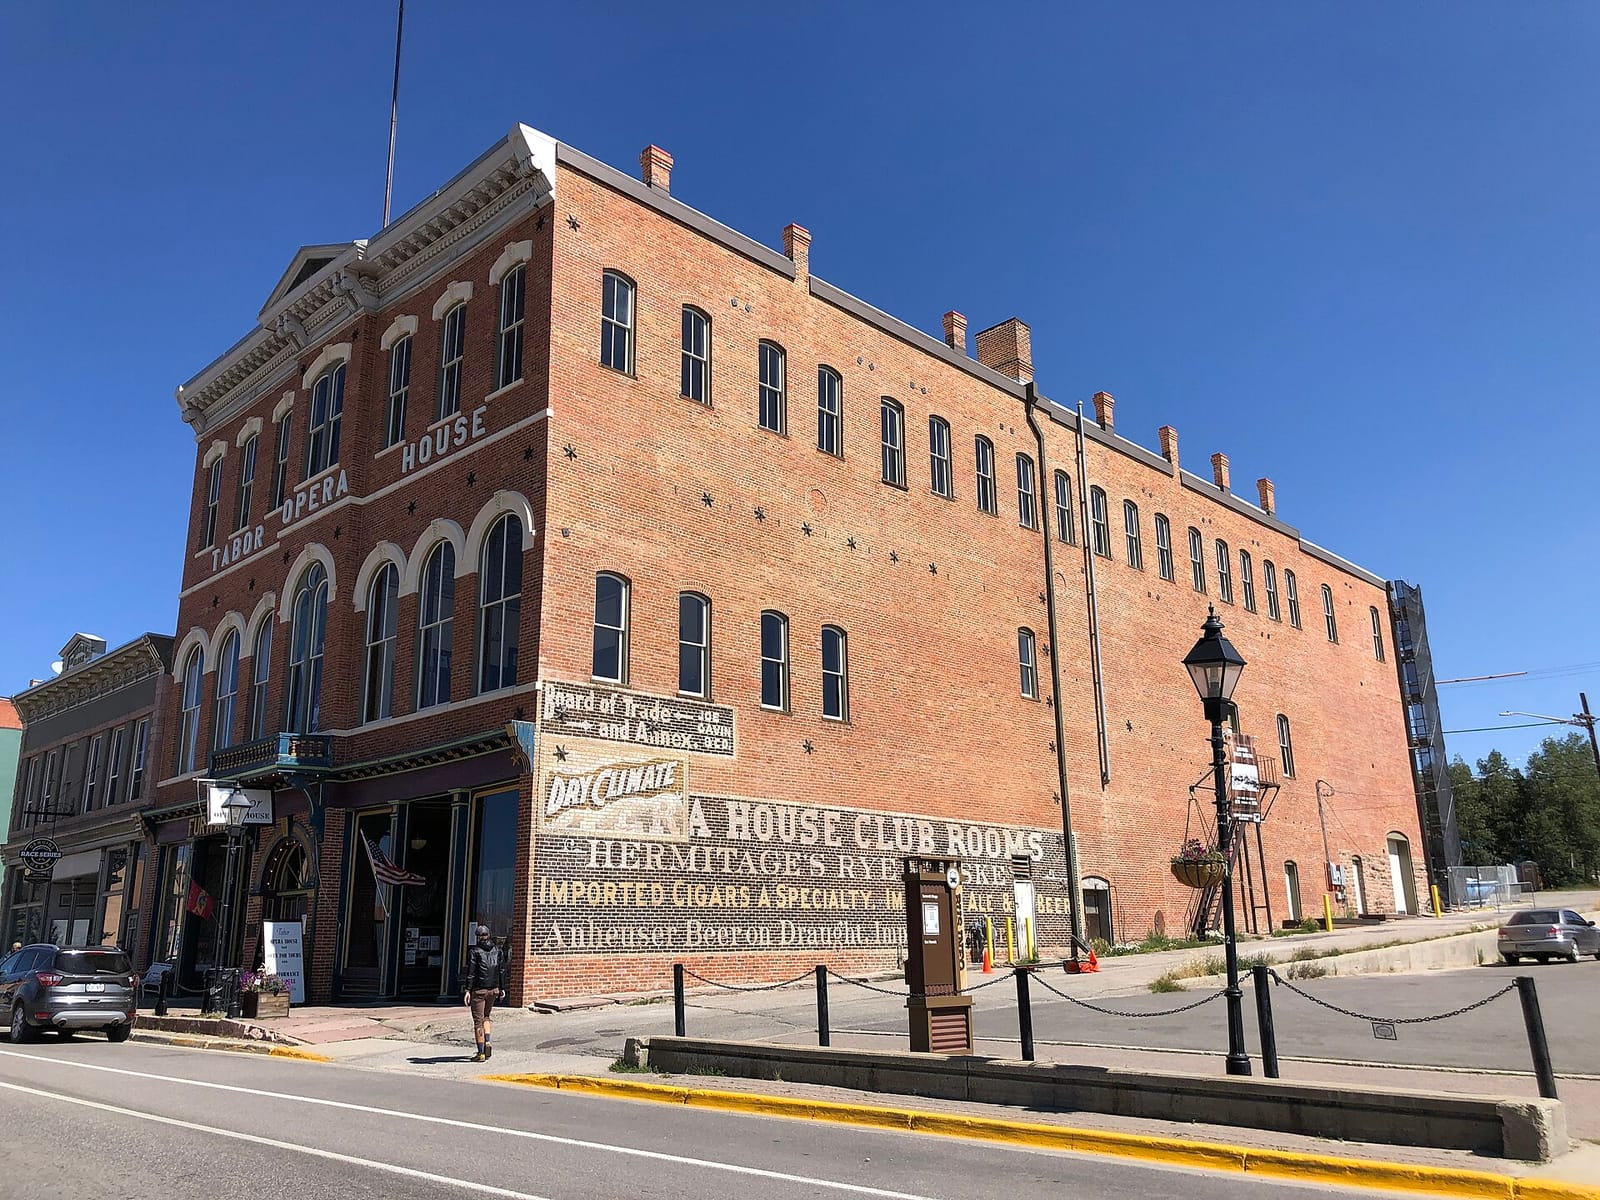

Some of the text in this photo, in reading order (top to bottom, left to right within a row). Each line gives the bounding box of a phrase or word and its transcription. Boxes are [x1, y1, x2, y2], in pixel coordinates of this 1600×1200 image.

[211, 405, 488, 572] TABOR OPERA HOUSE
[544, 683, 673, 722] Board of Trade
[699, 710, 720, 723] JOE
[598, 719, 630, 740] and
[591, 760, 679, 808] CLIMATE
[726, 799, 843, 848] HOUSE
[855, 814, 935, 854] CLUB
[947, 823, 1043, 862] ROOMS
[837, 854, 898, 880] RYE
[539, 875, 663, 907] IMPORTED
[672, 880, 750, 907] CIGARS
[757, 884, 771, 907] A
[967, 891, 994, 912] ALE
[1037, 893, 1071, 914] BEER
[542, 919, 680, 948] Anheuser
[685, 919, 742, 945] Beer
[746, 926, 771, 945] on
